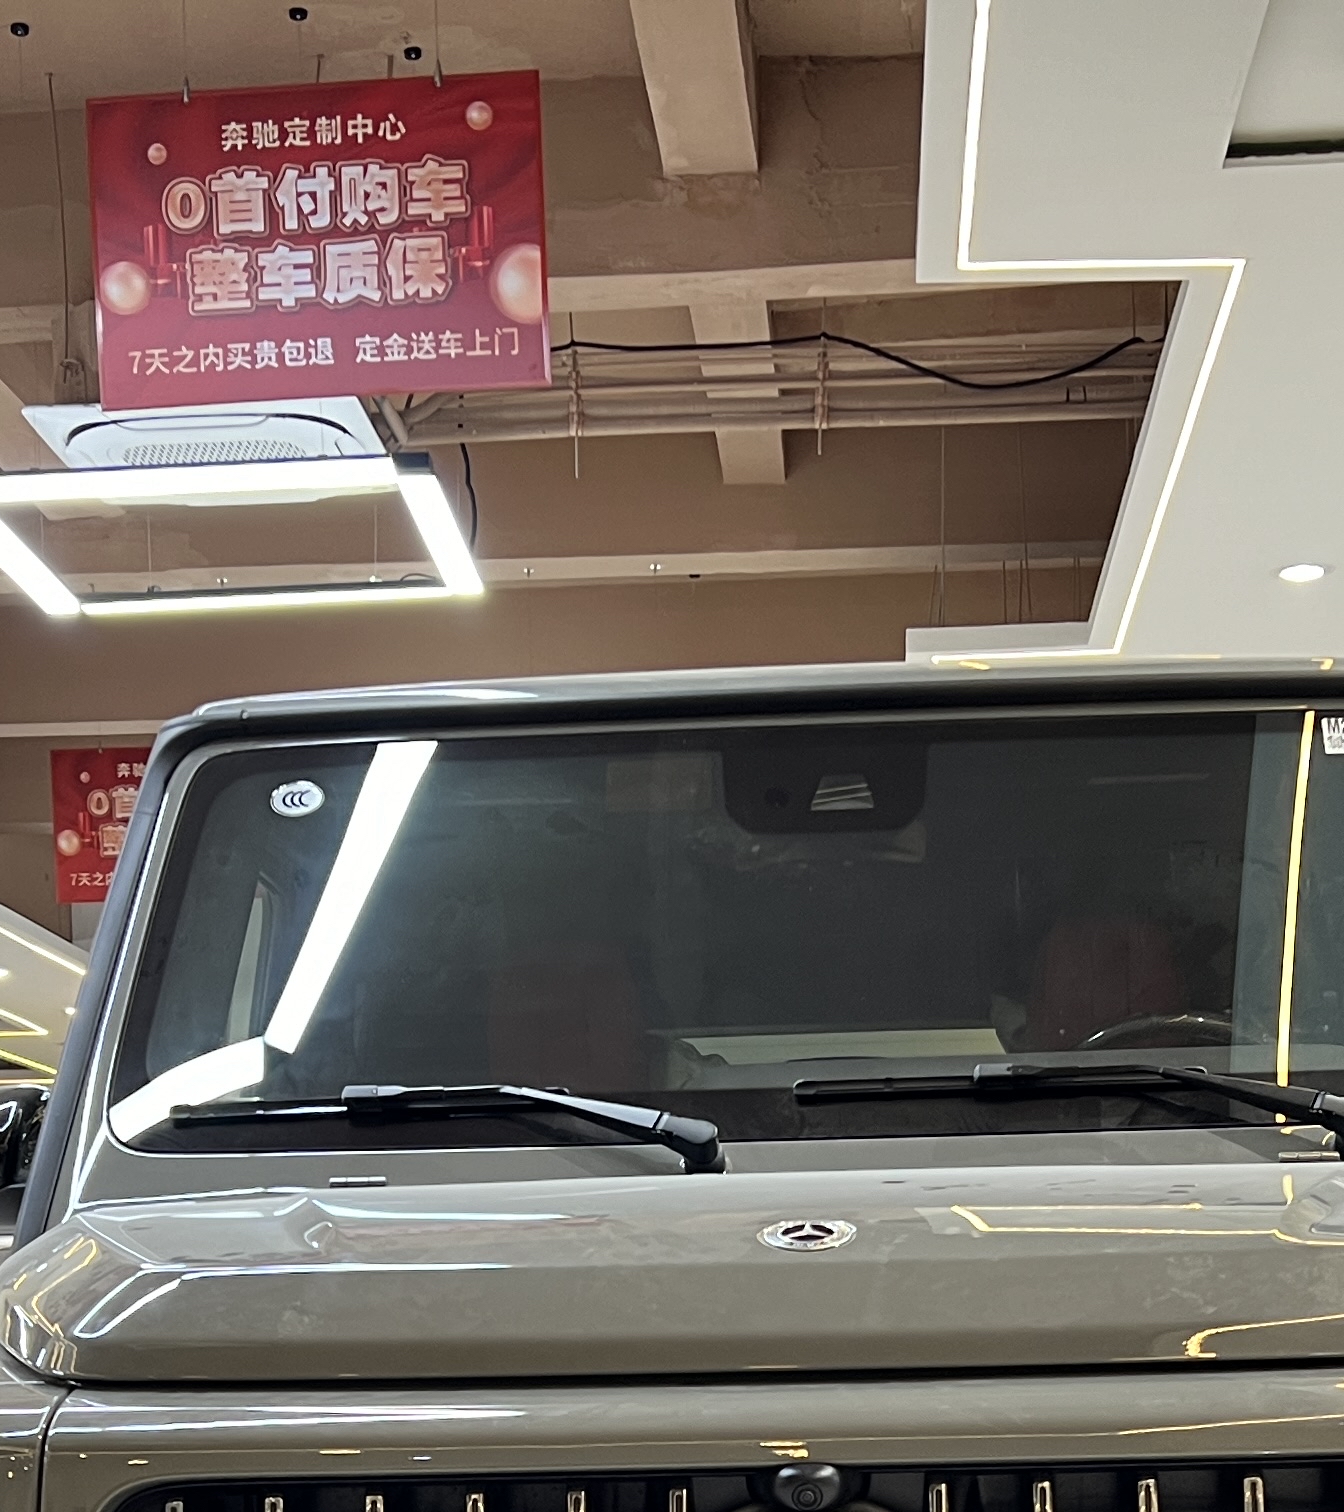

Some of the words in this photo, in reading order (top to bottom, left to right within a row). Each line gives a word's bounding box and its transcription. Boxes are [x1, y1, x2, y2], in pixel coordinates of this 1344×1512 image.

[221, 113, 406, 152] 奔驰定制中心
[165, 156, 468, 235] 0首付购车
[189, 235, 450, 313] 整车质保
[128, 336, 335, 376] 7天之内买贵包退
[355, 327, 520, 365] 定金送车上门
